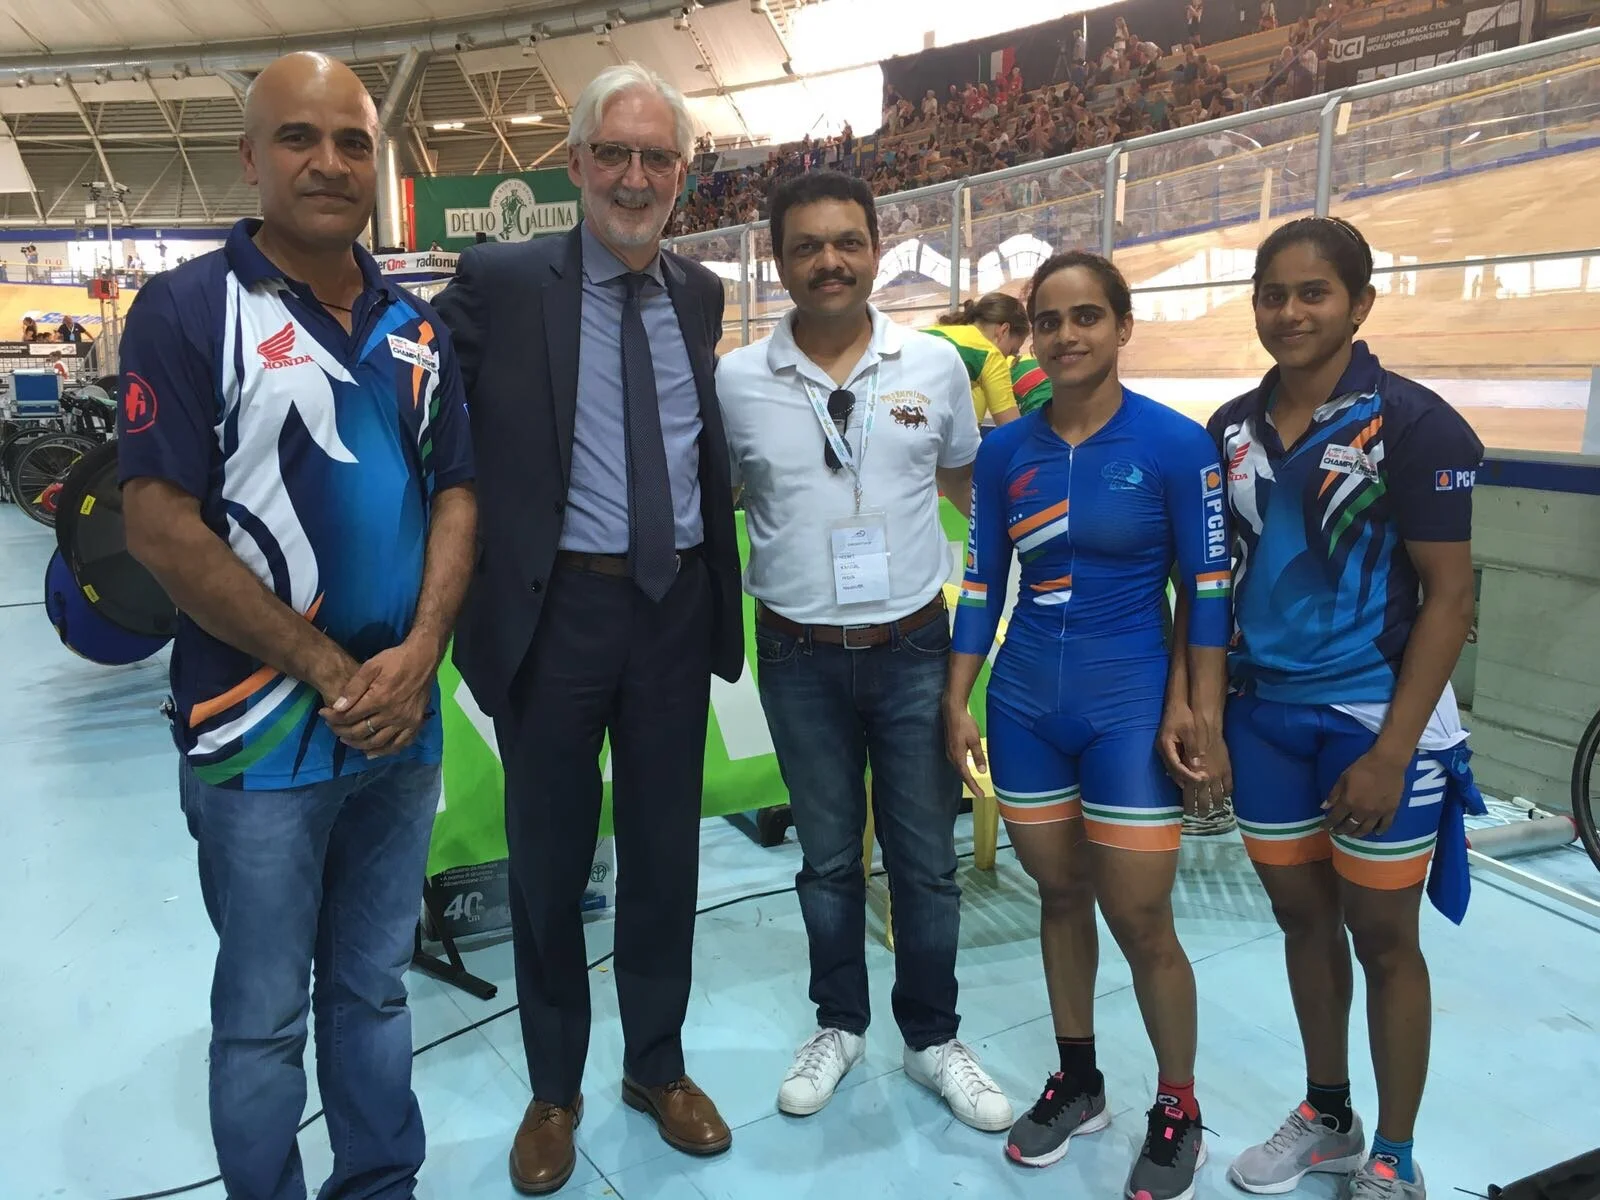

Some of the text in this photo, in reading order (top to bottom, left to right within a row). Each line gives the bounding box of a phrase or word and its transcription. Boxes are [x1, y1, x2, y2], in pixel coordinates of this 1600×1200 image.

[1366, 30, 1450, 53] WORLD CHAMPIONSHIPS
[1381, 29, 1406, 43] JUNIOR
[1407, 24, 1428, 36] TRACK
[1429, 18, 1461, 32] CYCLING
[1333, 38, 1362, 58] UCI
[451, 205, 574, 236] DELIO GALLINA
[263, 355, 314, 369] HONDA
[1207, 498, 1225, 558] PCRA
